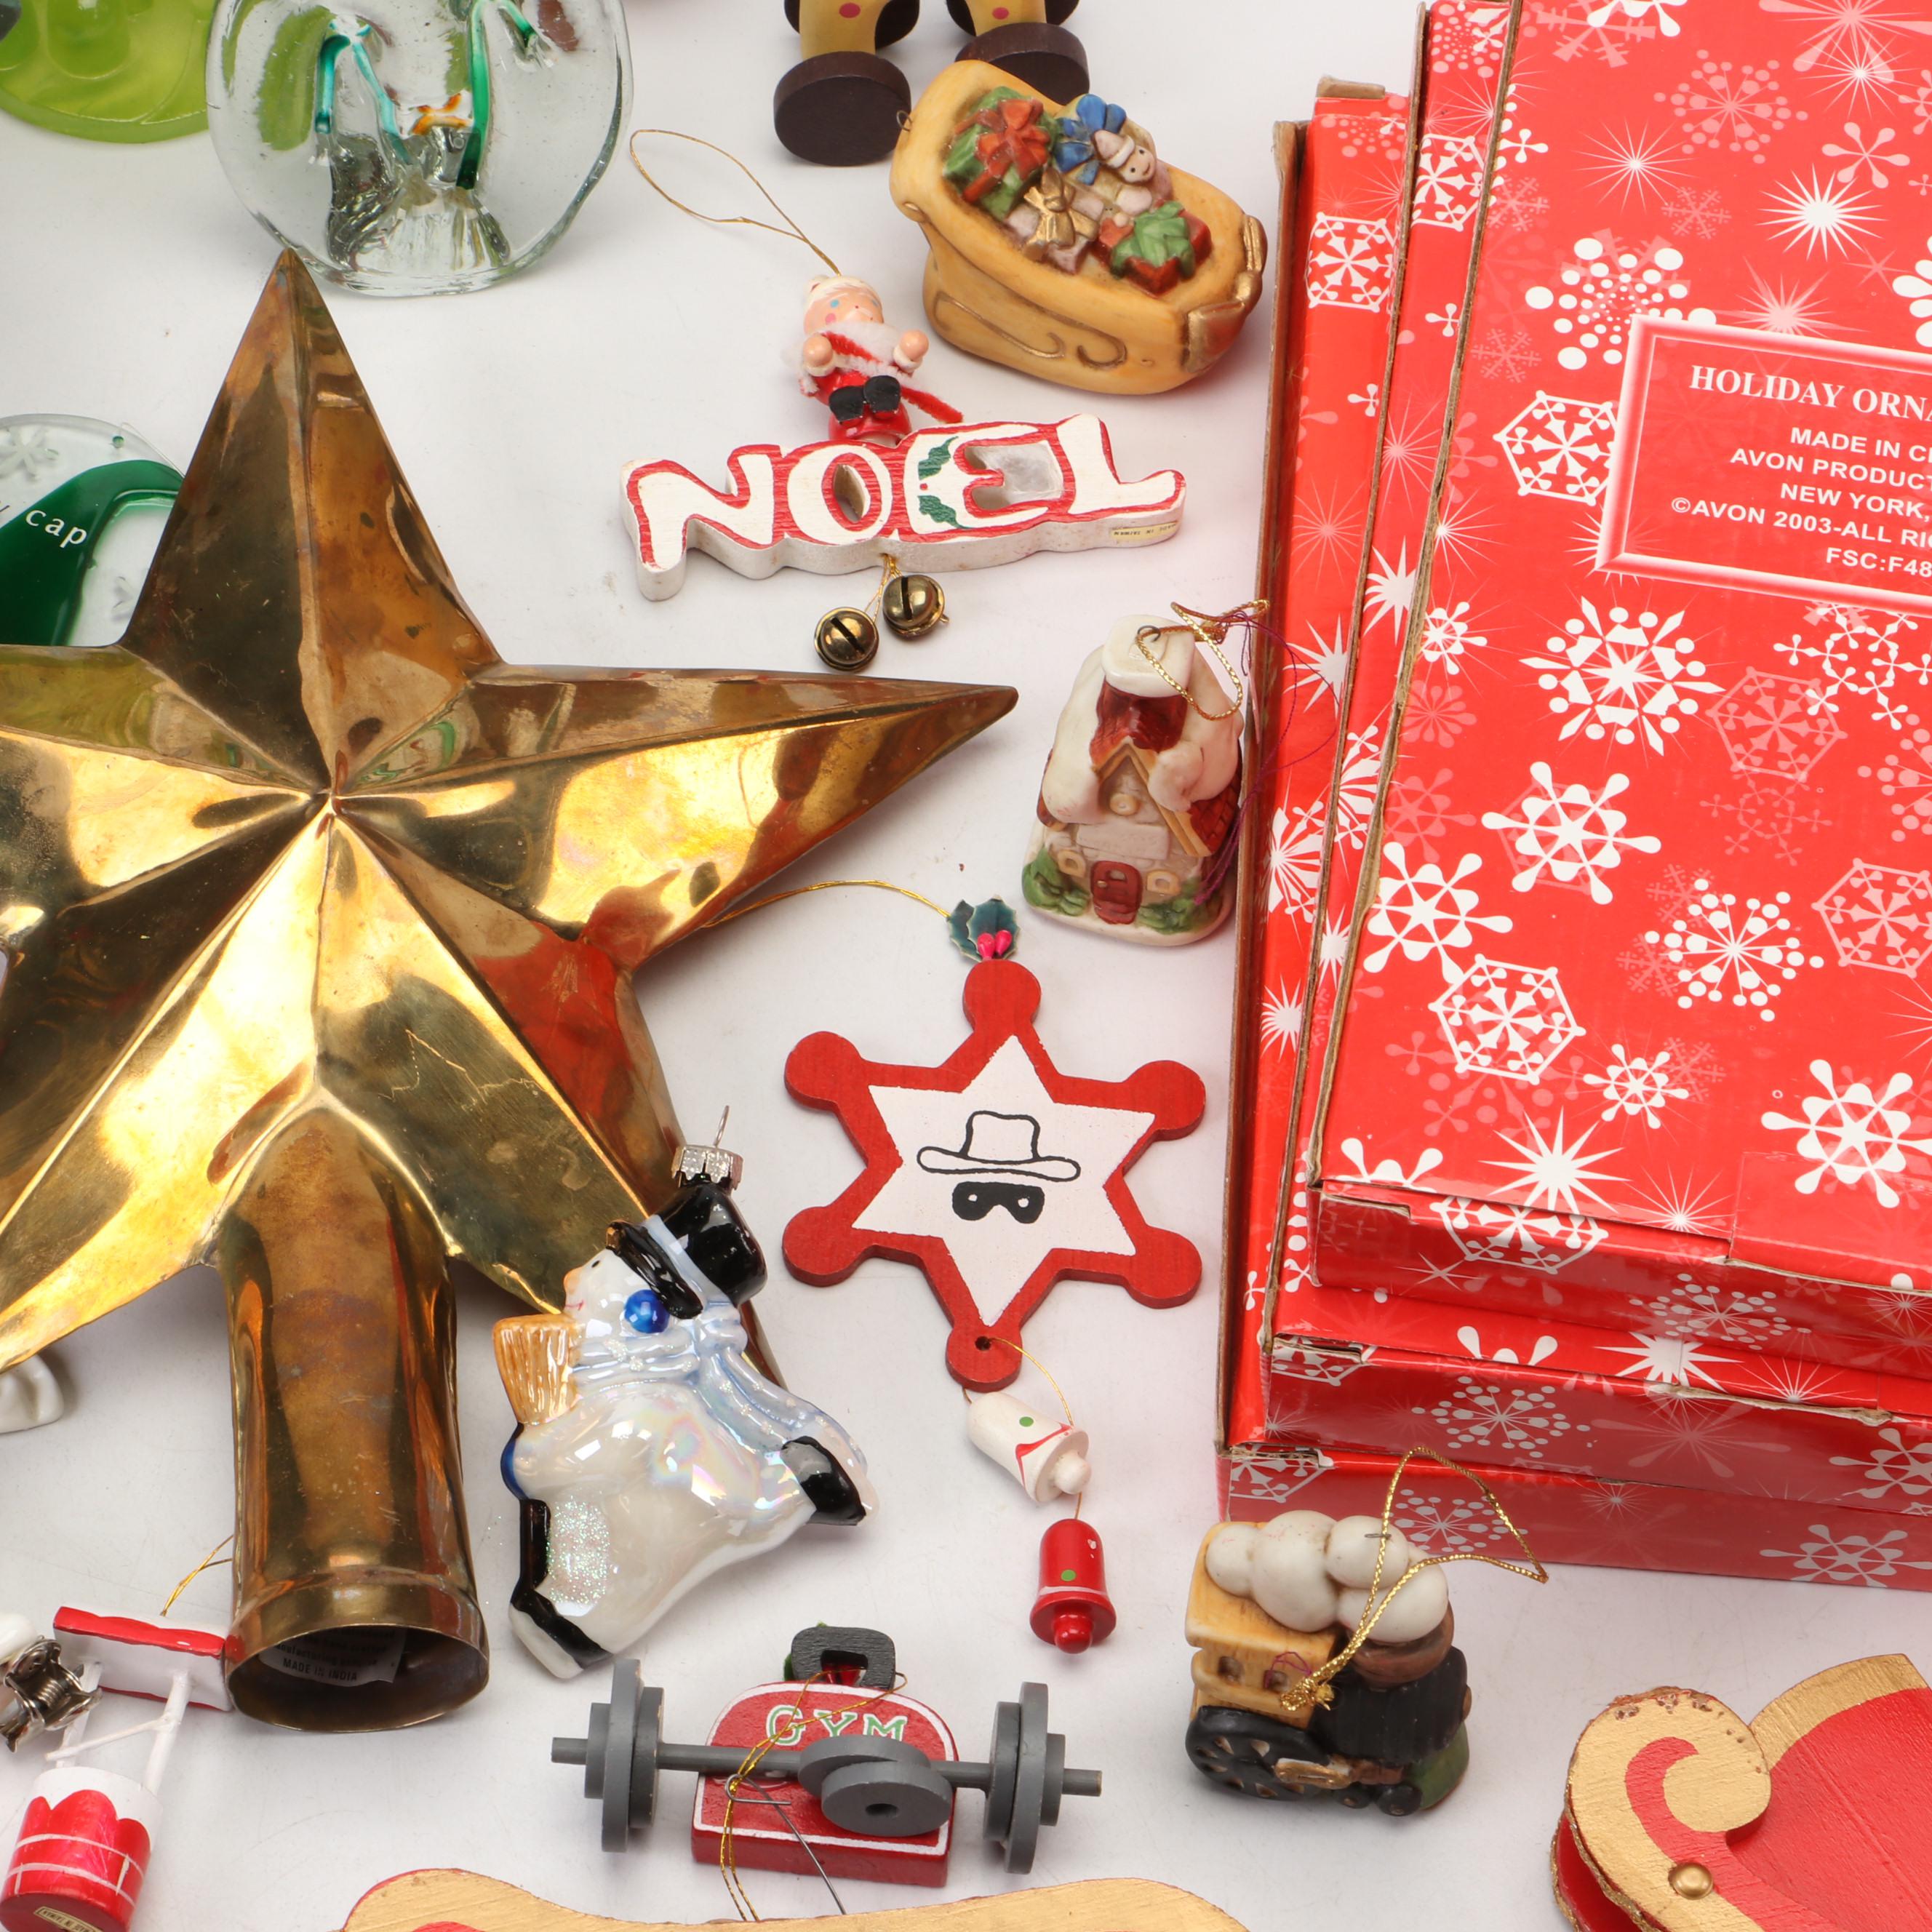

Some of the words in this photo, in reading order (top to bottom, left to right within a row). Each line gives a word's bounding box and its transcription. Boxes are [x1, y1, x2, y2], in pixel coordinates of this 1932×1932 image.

[1690, 366, 1844, 407] HOLIDAY
[1731, 449, 1803, 472] AVON
[1791, 428, 1867, 453] MADE
[1875, 440, 1900, 458] IN
[1909, 445, 1932, 463] C
[623, 414, 1186, 572] NOEL
[1781, 483, 1841, 506] NEW
[1850, 493, 1929, 522] YORK,
[25, 510, 87, 548] cap
[1773, 511, 1891, 542] 2003-ALL
[1827, 548, 1932, 577] FSC:F48
[283, 1658, 311, 1673] MADE
[315, 1667, 324, 1677] IN
[329, 1669, 357, 1681] INDIA
[766, 1704, 909, 1746] GYM
